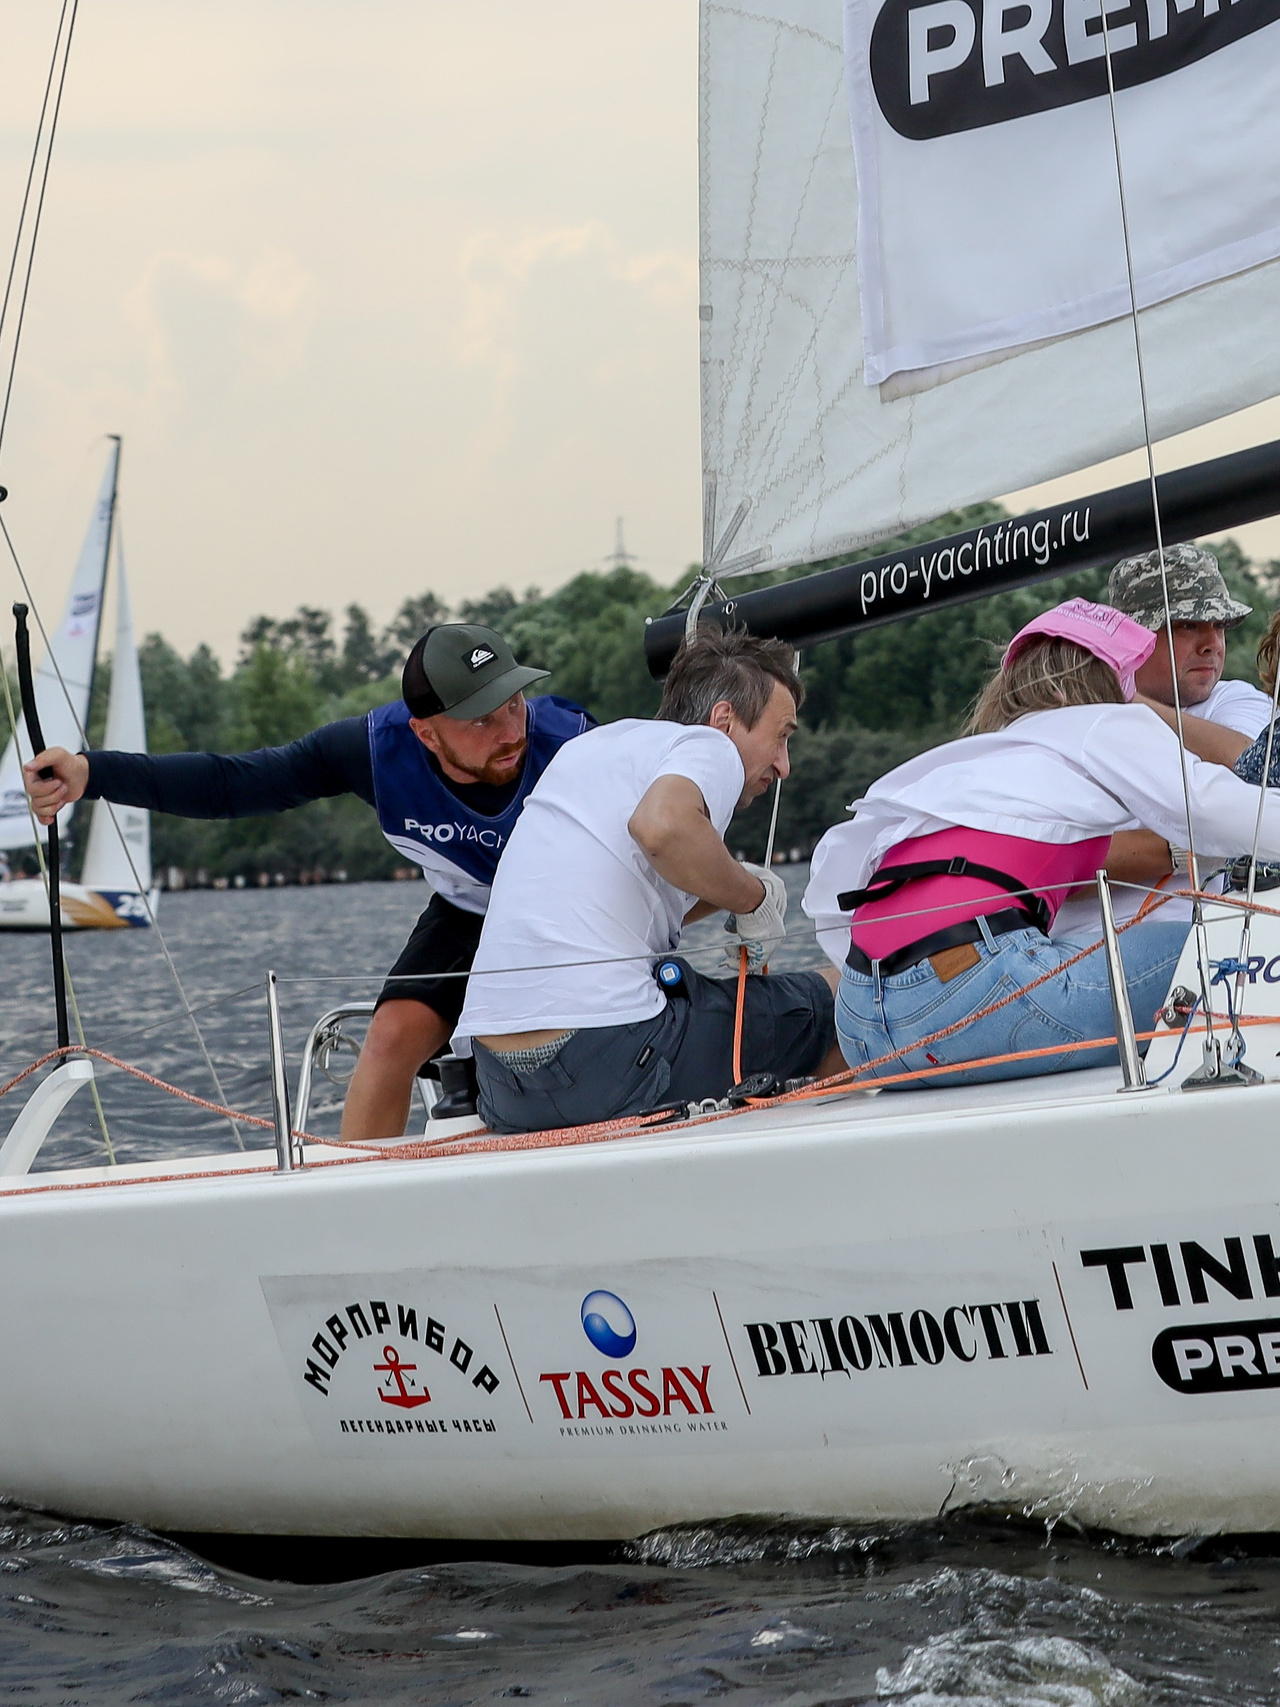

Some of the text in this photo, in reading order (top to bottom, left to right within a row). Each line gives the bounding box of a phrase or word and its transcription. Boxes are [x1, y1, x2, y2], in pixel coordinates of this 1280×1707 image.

[860, 506, 1091, 616] pro-yachting.ru
[303, 1300, 500, 1397] МОРПРИБОР
[743, 1299, 1054, 1381] ВЕДОМОСТИ
[539, 1364, 715, 1419] TASSAY
[340, 1418, 496, 1434] ЛЕГЕНДАРНЫЕ ЧАСЫ
[559, 1421, 728, 1437] PREMIUM DRINKING WATER
